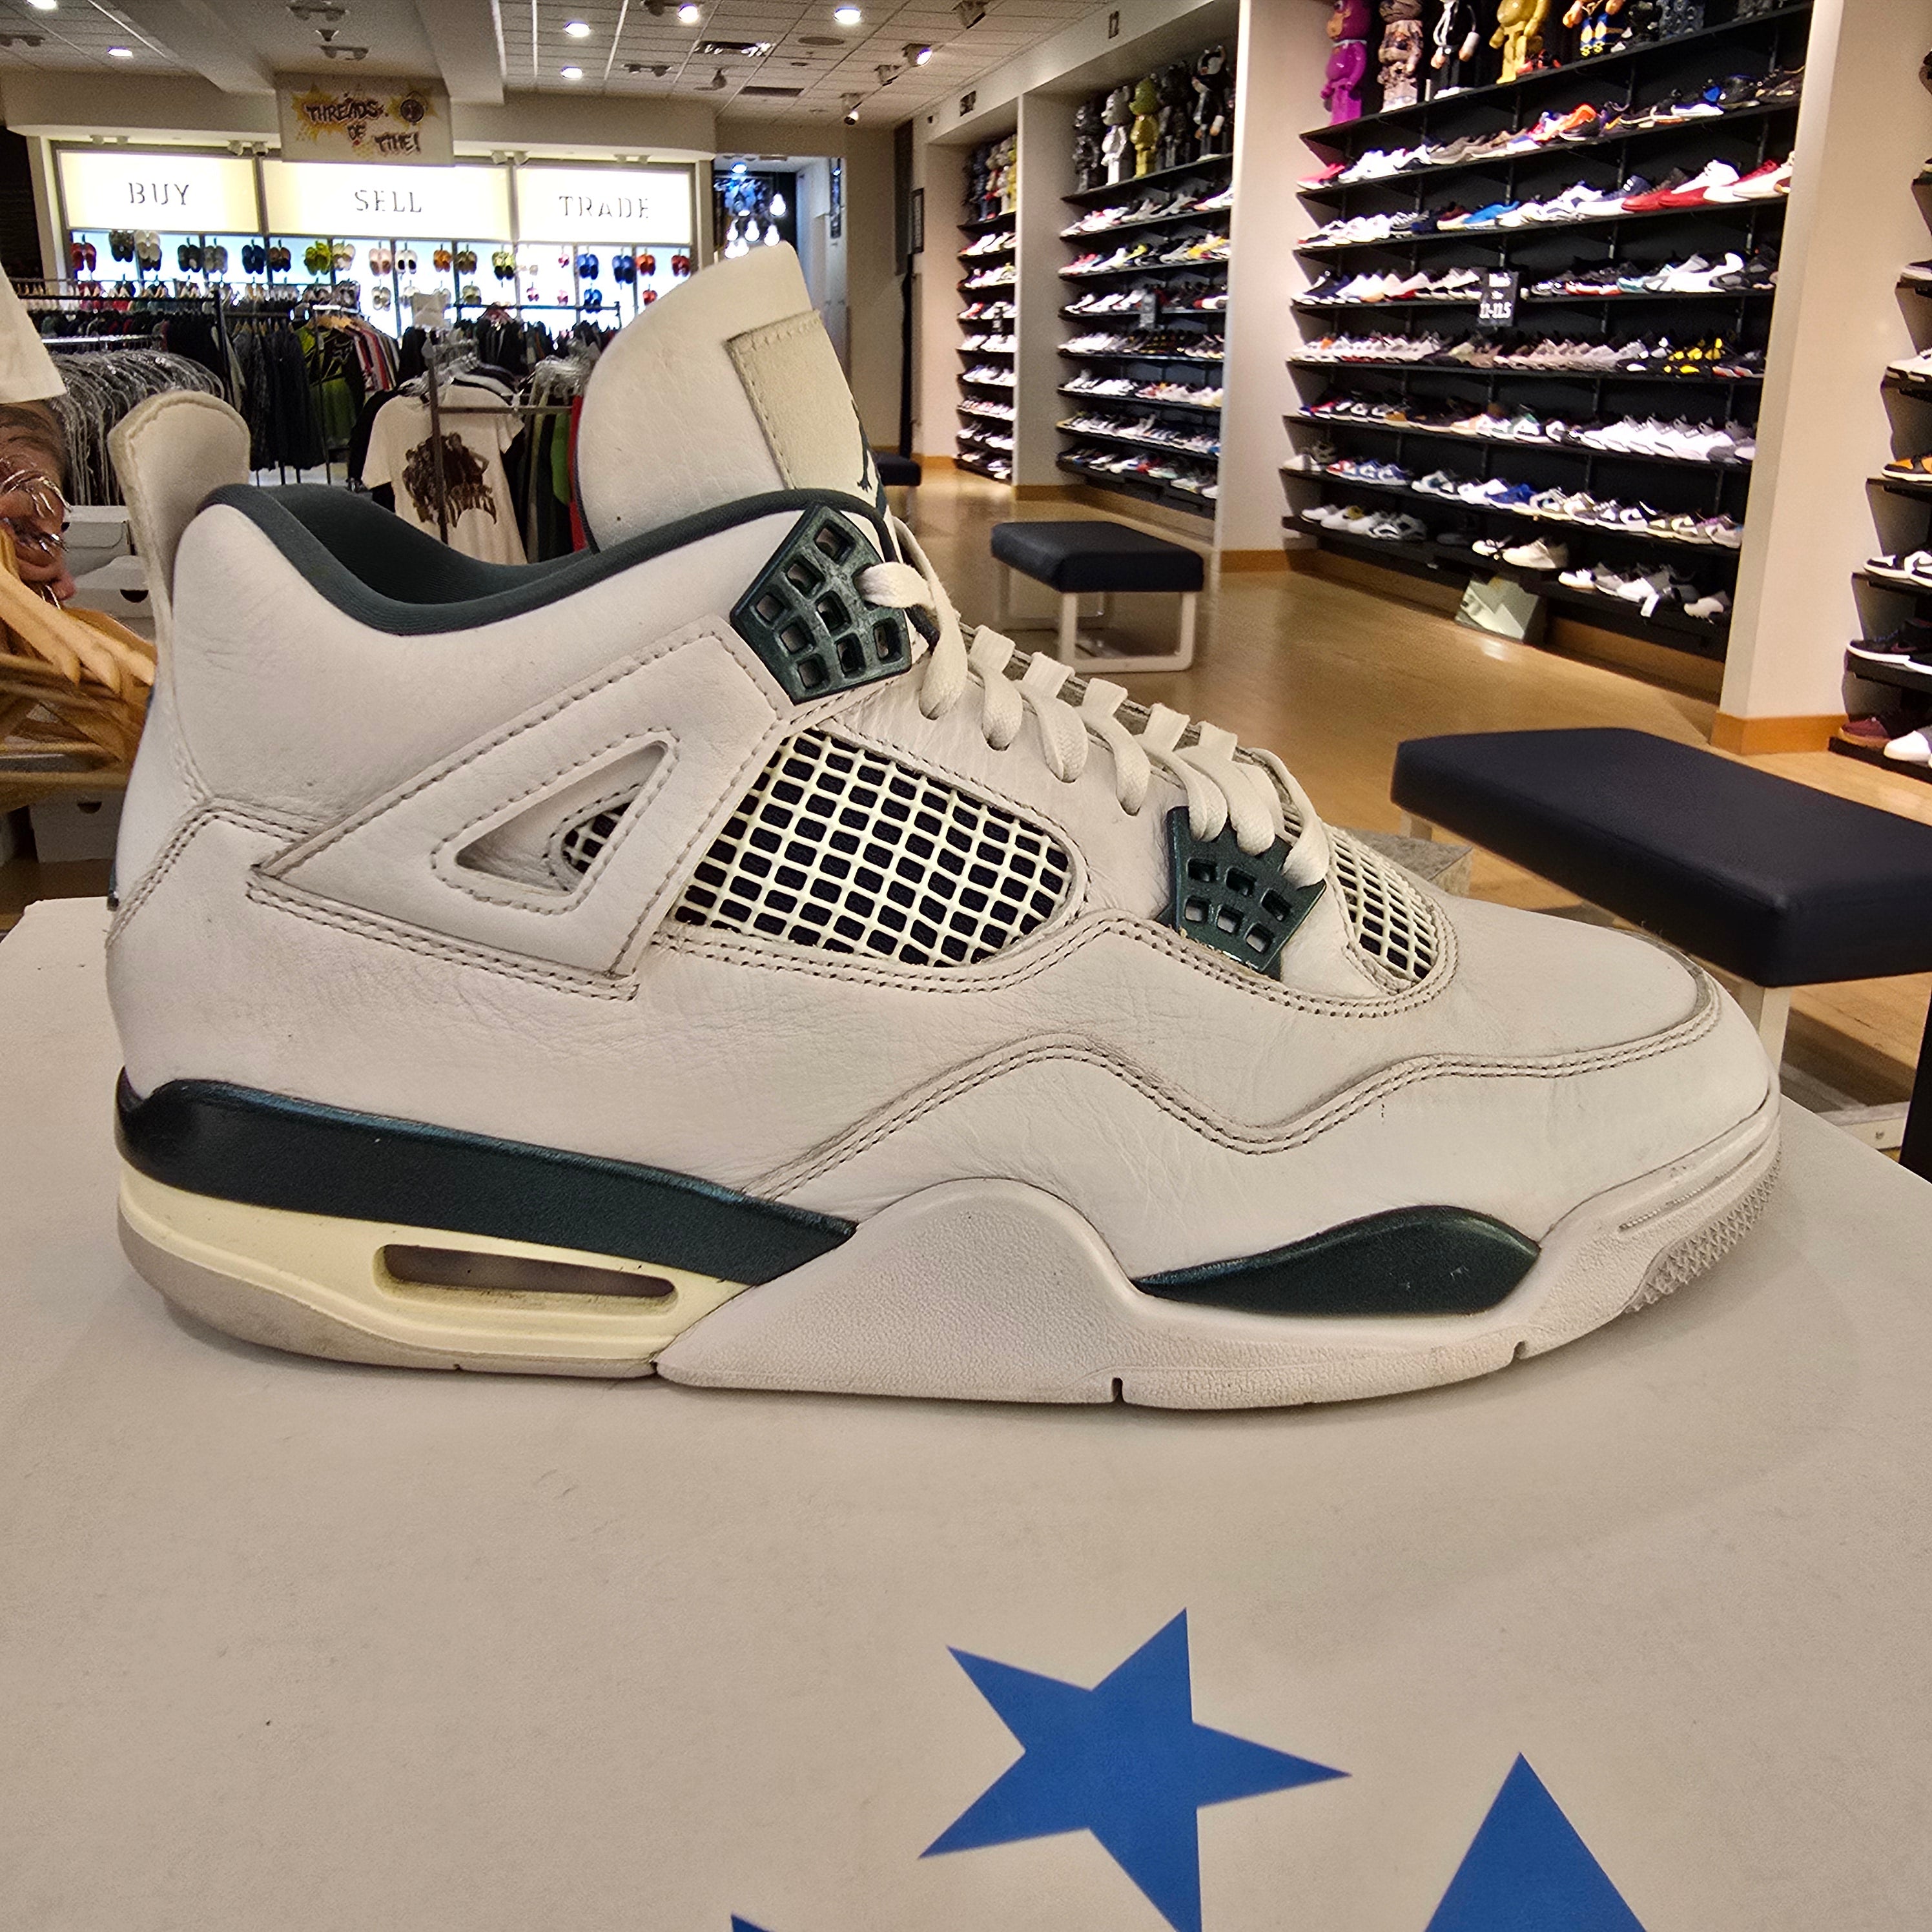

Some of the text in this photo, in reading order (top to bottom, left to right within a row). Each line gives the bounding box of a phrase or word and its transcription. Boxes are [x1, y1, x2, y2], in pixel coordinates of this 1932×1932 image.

[128, 182, 189, 205] BUY
[355, 189, 422, 212] SELL
[559, 196, 648, 218] TRADE
